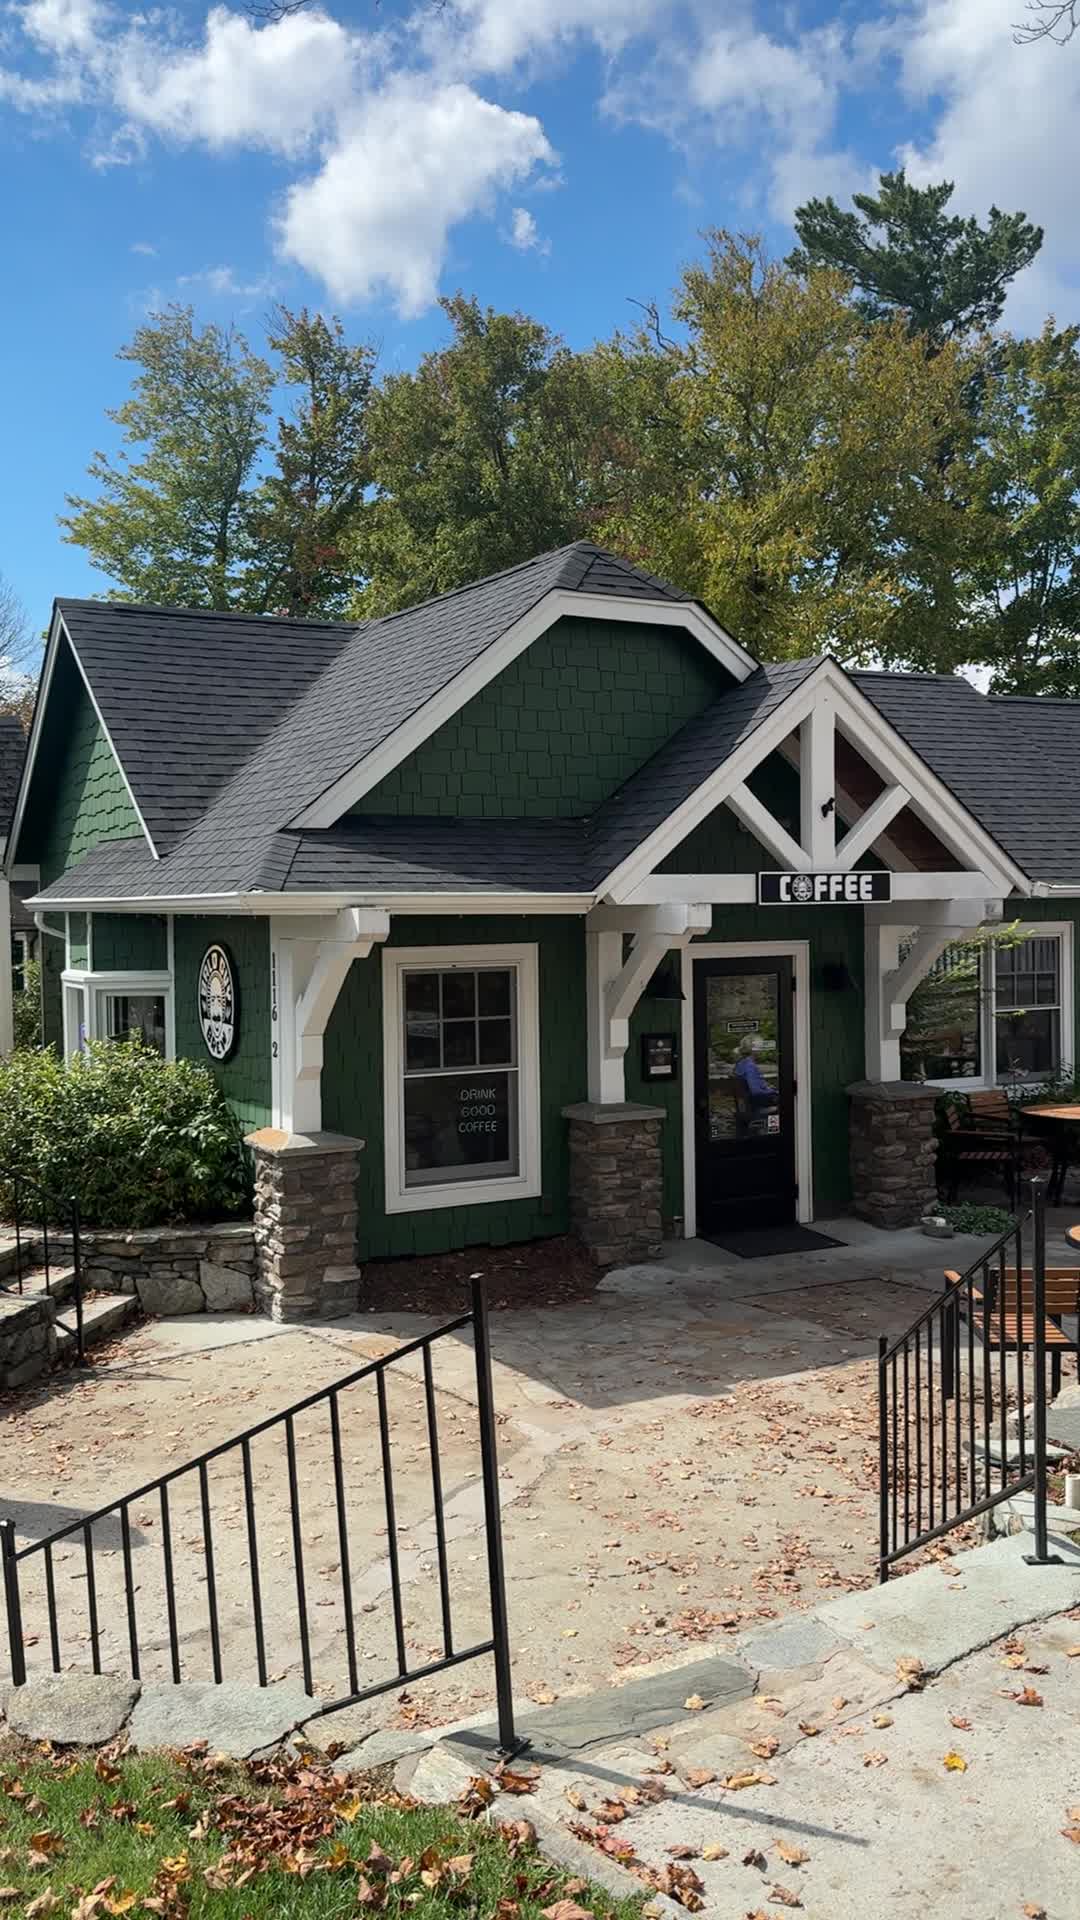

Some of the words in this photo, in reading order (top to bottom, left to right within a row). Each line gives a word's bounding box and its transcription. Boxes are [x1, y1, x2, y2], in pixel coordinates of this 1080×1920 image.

[780, 875, 873, 901] COFFEE
[460, 1088, 496, 1101] DRINK
[462, 1104, 496, 1118] GOOD
[458, 1120, 497, 1133] COFFEE
